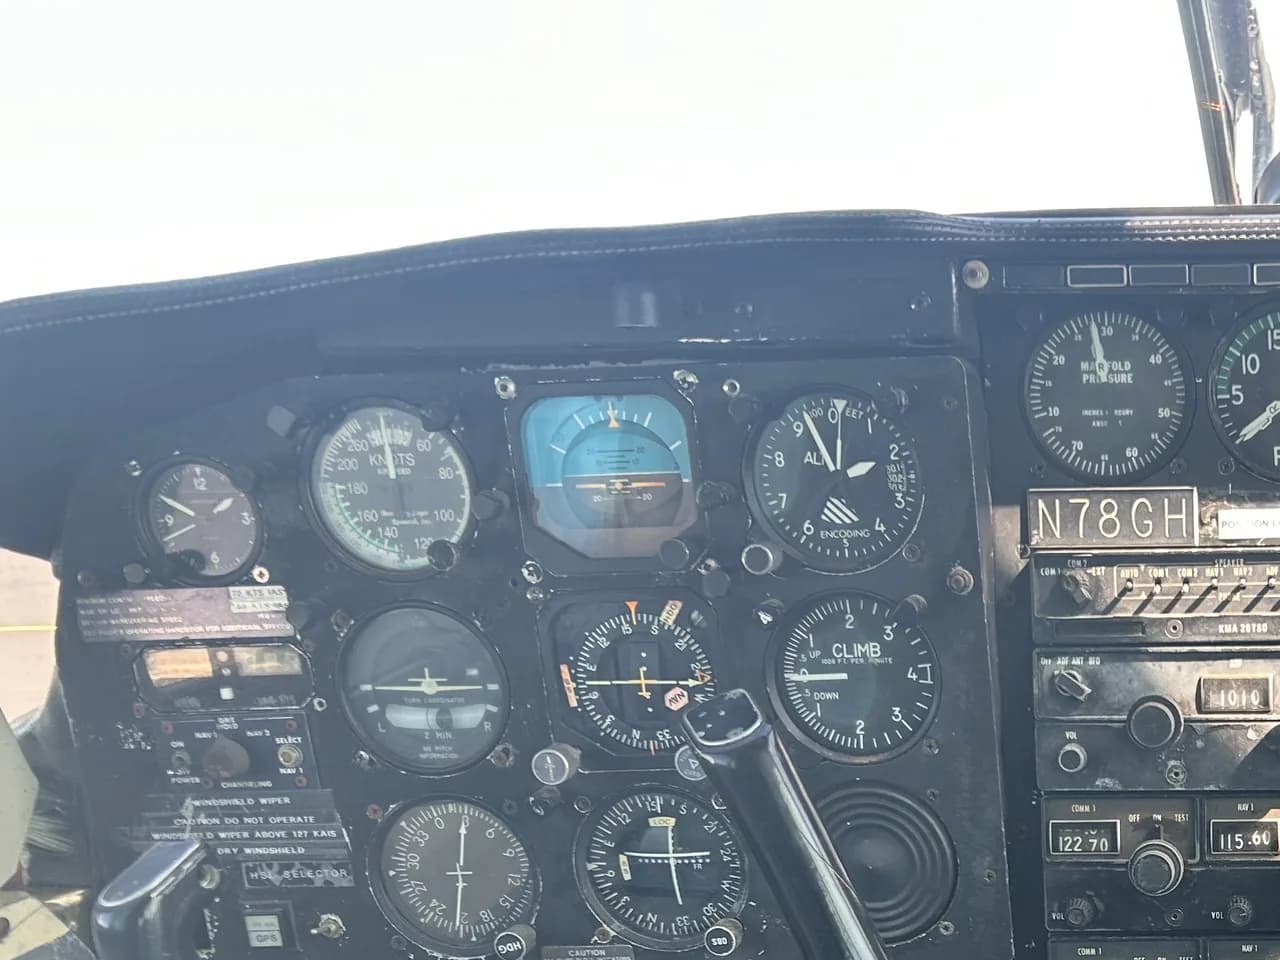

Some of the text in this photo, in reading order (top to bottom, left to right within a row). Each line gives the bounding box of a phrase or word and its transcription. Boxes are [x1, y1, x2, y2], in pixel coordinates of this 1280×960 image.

[1052, 355, 1065, 365] 20
[1149, 354, 1162, 364] 40
[1241, 353, 1260, 375] 10
[1231, 385, 1244, 405] 5
[1157, 408, 1170, 418] 50
[417, 440, 431, 451] 60
[1125, 448, 1138, 458] 60
[337, 459, 358, 470] 200
[439, 468, 453, 479] 80
[193, 479, 208, 490] 12
[347, 483, 368, 495] 180
[359, 511, 378, 522] 160
[435, 510, 454, 521] 100
[1038, 498, 1188, 538] N78GH
[378, 527, 398, 538] 140
[820, 529, 871, 539] ENCODING
[1120, 569, 1139, 578] AUTO
[845, 614, 855, 629] 2
[1219, 624, 1238, 633] KMA
[809, 642, 881, 659] UP CLIMB
[669, 691, 686, 706] NAV
[814, 692, 839, 700] DOWN
[1065, 732, 1078, 740] VOL
[260, 797, 290, 805] WIPER
[1072, 805, 1090, 813] COMM
[174, 816, 316, 826] CAUTION DO NOT OPERATE
[1129, 814, 1140, 822] OFF
[1175, 814, 1189, 822] TEST
[218, 831, 249, 839] WIPER
[413, 830, 430, 847] 33
[243, 847, 305, 855] WINDSHIELD
[407, 853, 421, 870] 30
[283, 869, 348, 880] SELECTOR
[410, 880, 428, 894] 27
[430, 898, 446, 915] 24
[256, 934, 278, 943] GPS
[498, 941, 522, 954] HDG
[1078, 948, 1096, 956] COMM
